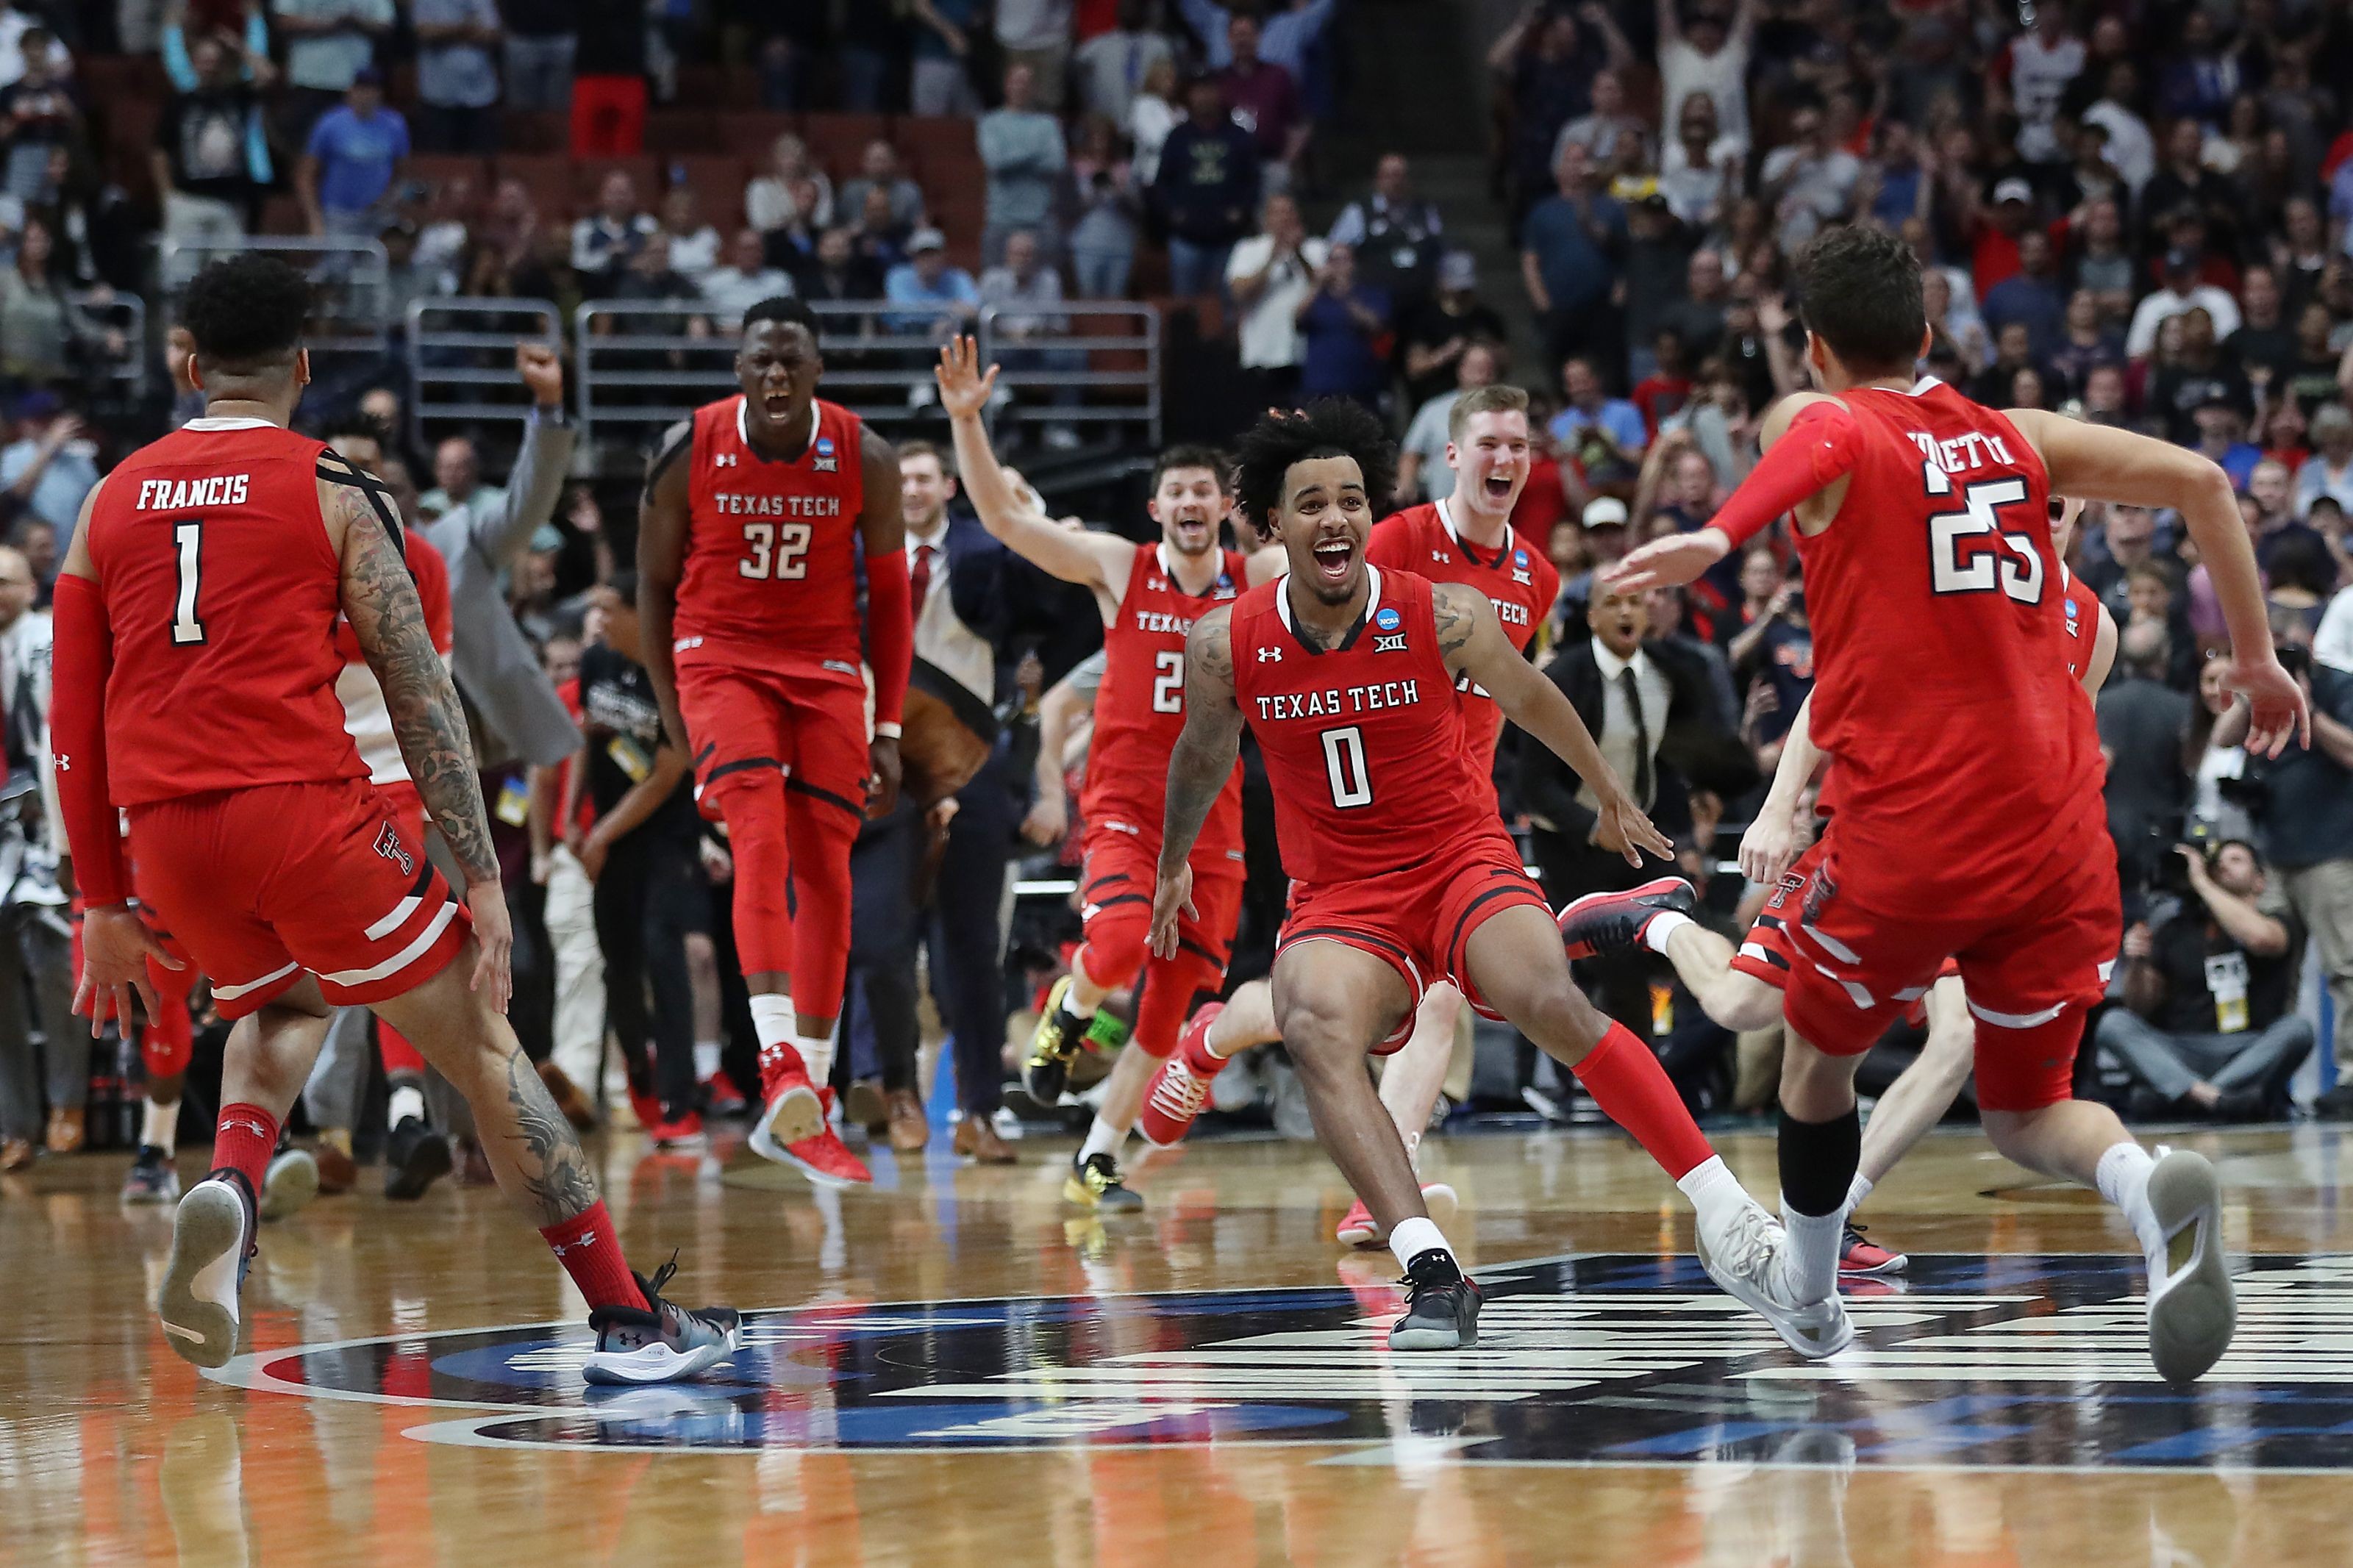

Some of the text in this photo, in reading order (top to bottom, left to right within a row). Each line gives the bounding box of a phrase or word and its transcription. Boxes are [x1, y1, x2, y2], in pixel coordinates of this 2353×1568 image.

[135, 473, 250, 510] FRANCIS
[715, 493, 840, 516] TEXAS TECH
[738, 522, 813, 579] 32
[1924, 460, 2044, 604] 25
[171, 521, 206, 645] 1
[1379, 617, 1400, 625] NCAA
[1490, 597, 1529, 626] TECH
[1374, 633, 1407, 652] XII
[1256, 690, 1341, 720] TEXAS
[1347, 679, 1419, 711] TECH
[1321, 726, 1372, 808] 0
